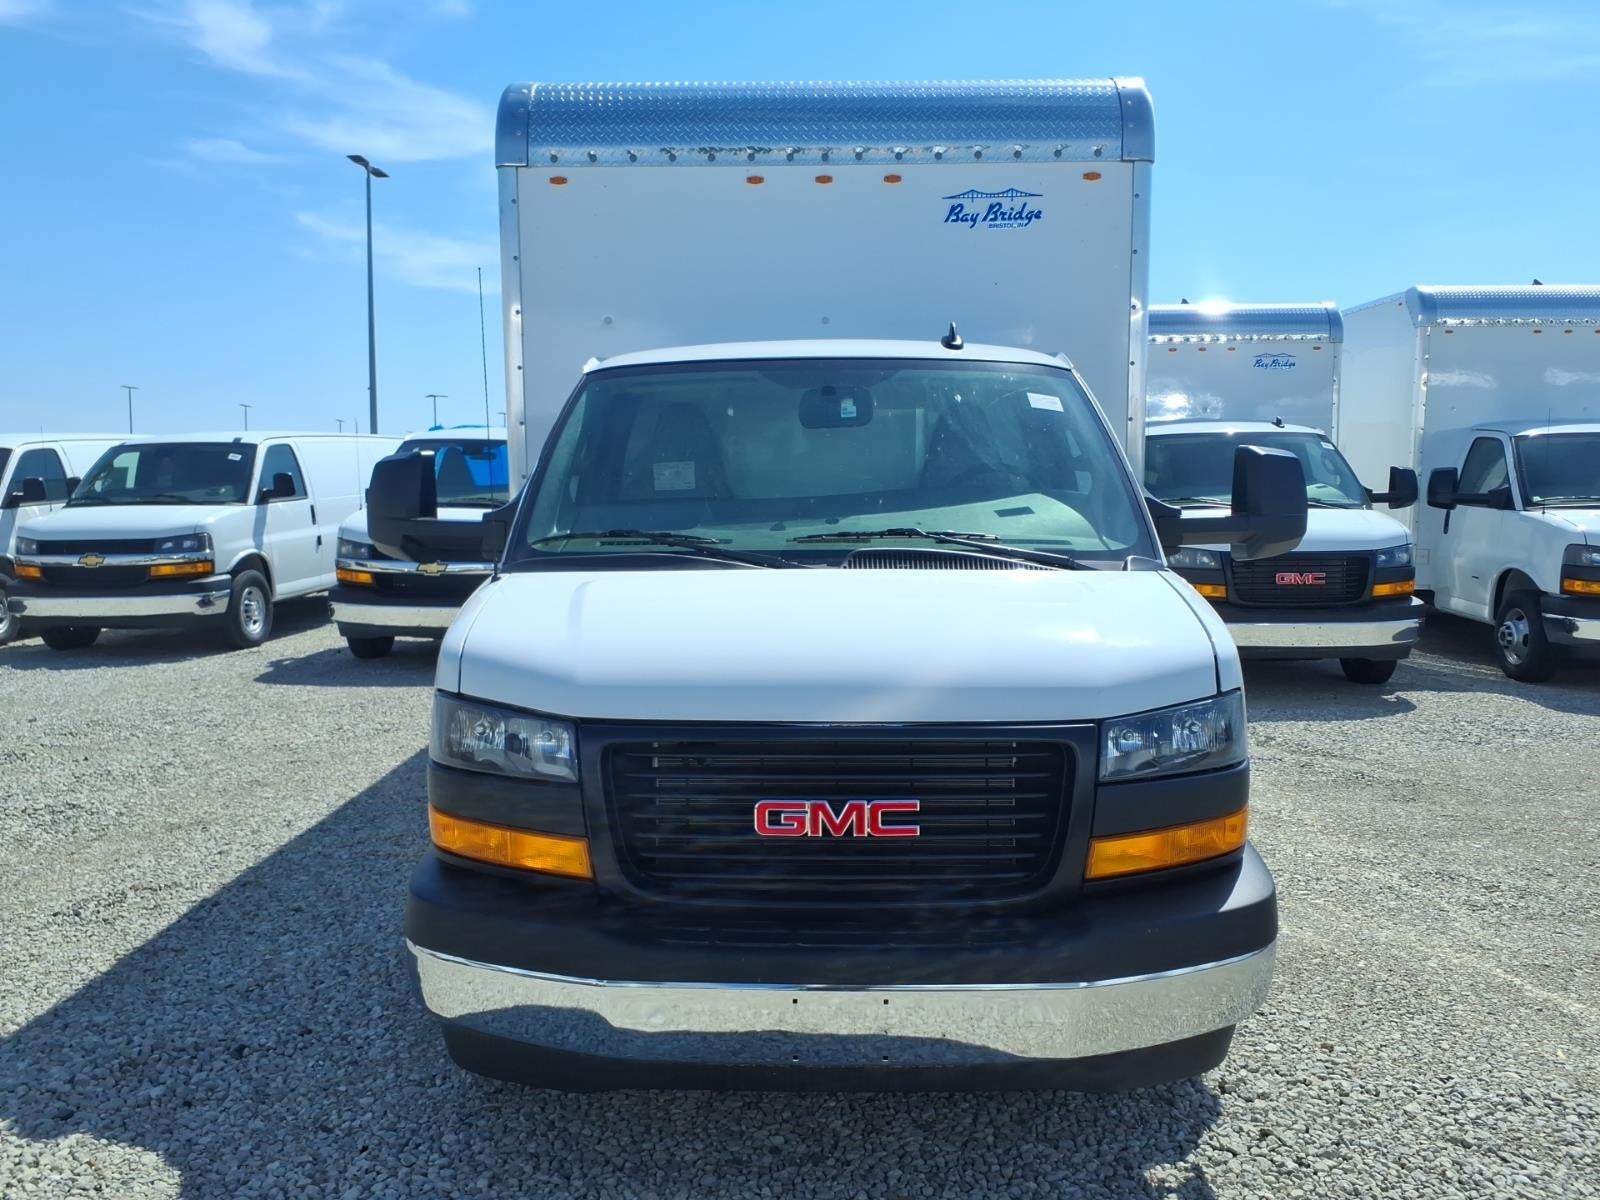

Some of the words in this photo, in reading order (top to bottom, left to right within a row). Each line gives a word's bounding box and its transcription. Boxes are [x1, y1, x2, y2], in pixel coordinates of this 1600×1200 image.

[944, 203, 980, 229] Bay
[981, 202, 1042, 227] Bridge
[1253, 358, 1269, 369] Bay
[1270, 358, 1296, 369] Bridge
[1275, 572, 1327, 585] GMC
[754, 799, 920, 837] GMC
